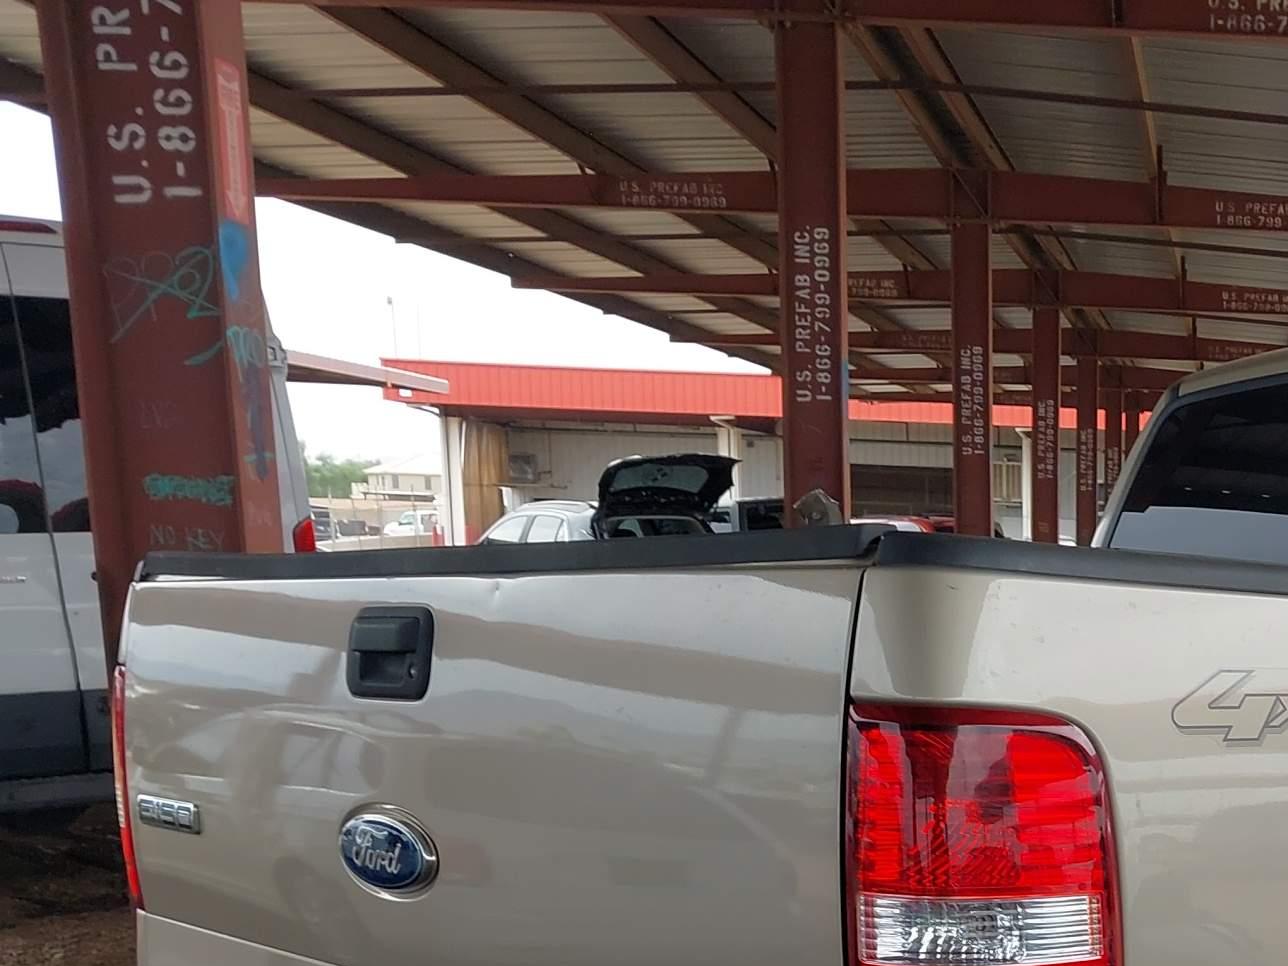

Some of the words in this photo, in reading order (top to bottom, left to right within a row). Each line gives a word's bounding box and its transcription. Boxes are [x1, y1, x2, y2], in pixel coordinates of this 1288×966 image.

[107, 107, 152, 203] U.S.
[794, 225, 810, 263] INC.
[795, 274, 811, 352] PREFAB
[814, 227, 832, 401] 1-866-799-0969
[796, 364, 812, 402] U.S.
[350, 824, 403, 876] Ford
